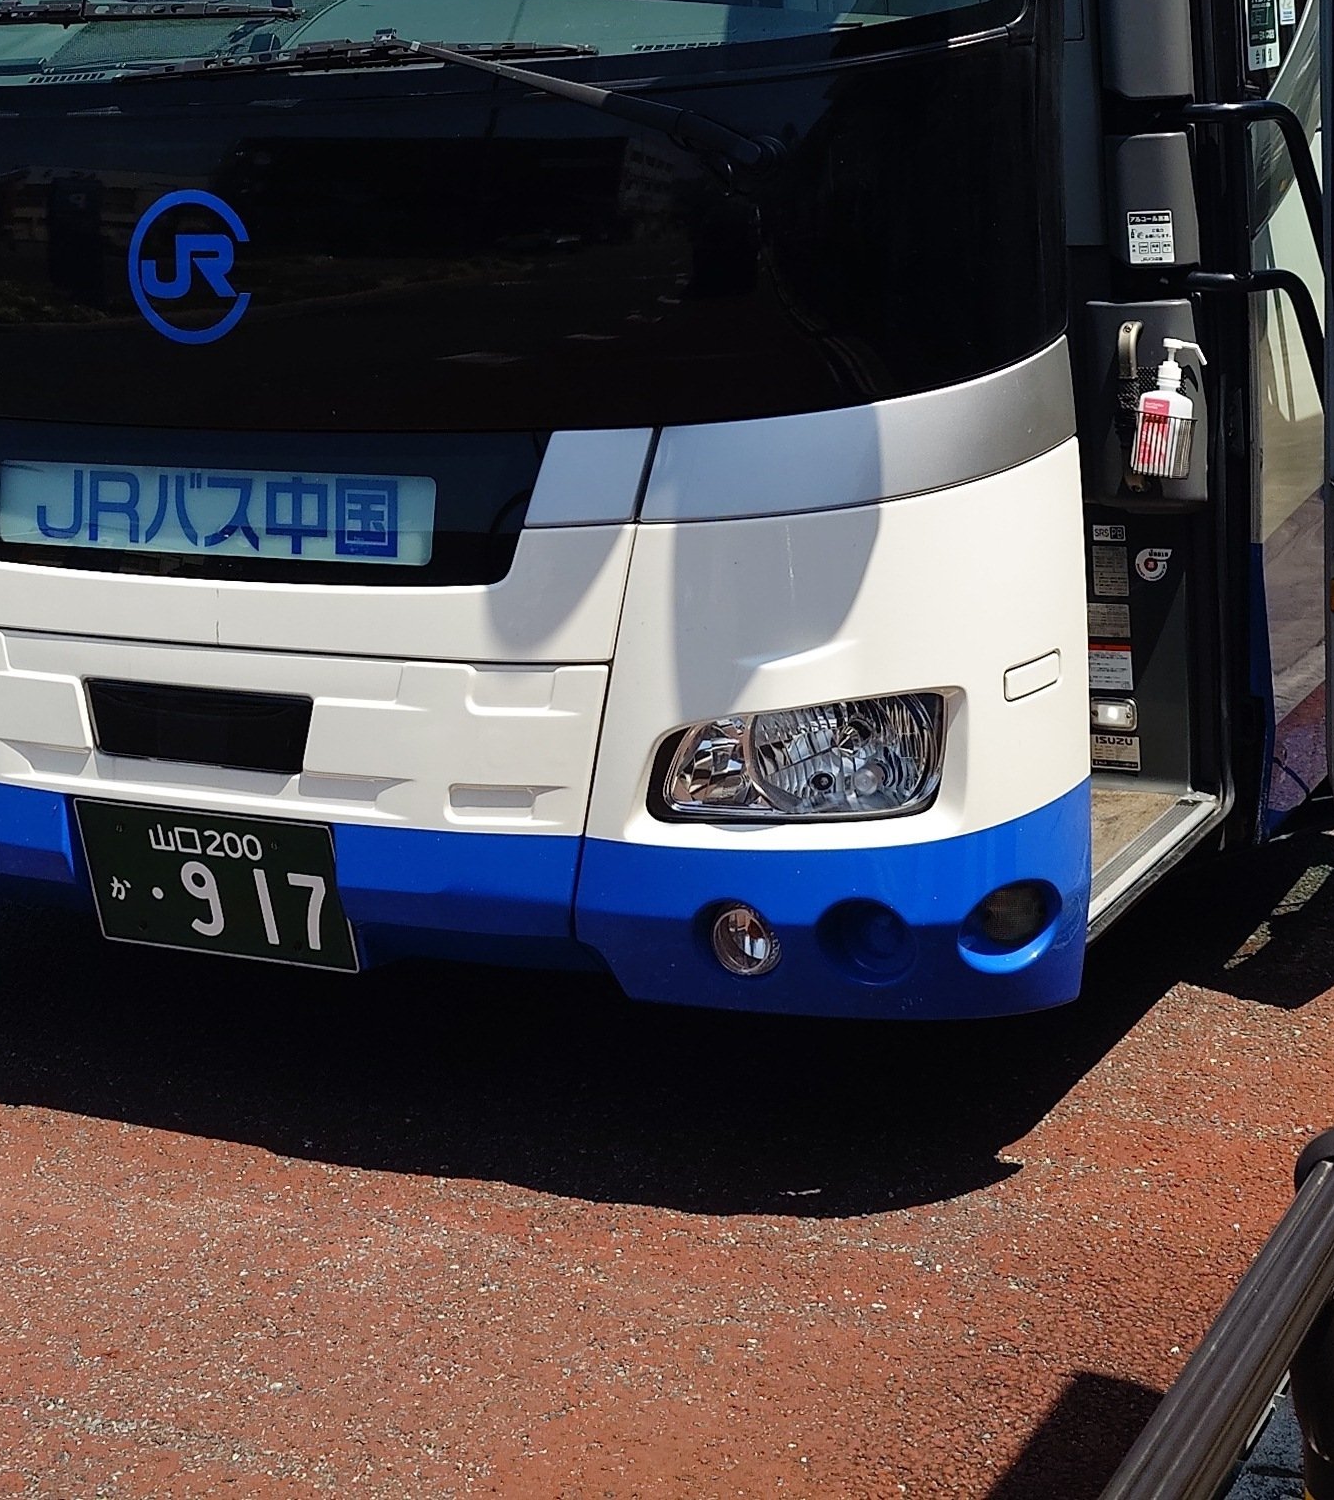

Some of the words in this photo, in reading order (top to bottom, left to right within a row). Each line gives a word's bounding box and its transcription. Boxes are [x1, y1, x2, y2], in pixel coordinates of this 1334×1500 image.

[36, 469, 398, 557] JRバス中国
[1095, 528, 1110, 537] SRS
[1111, 527, 1124, 539] PB
[1095, 736, 1133, 746] ISUZU
[148, 823, 263, 861] 山口200
[110, 876, 132, 900] か
